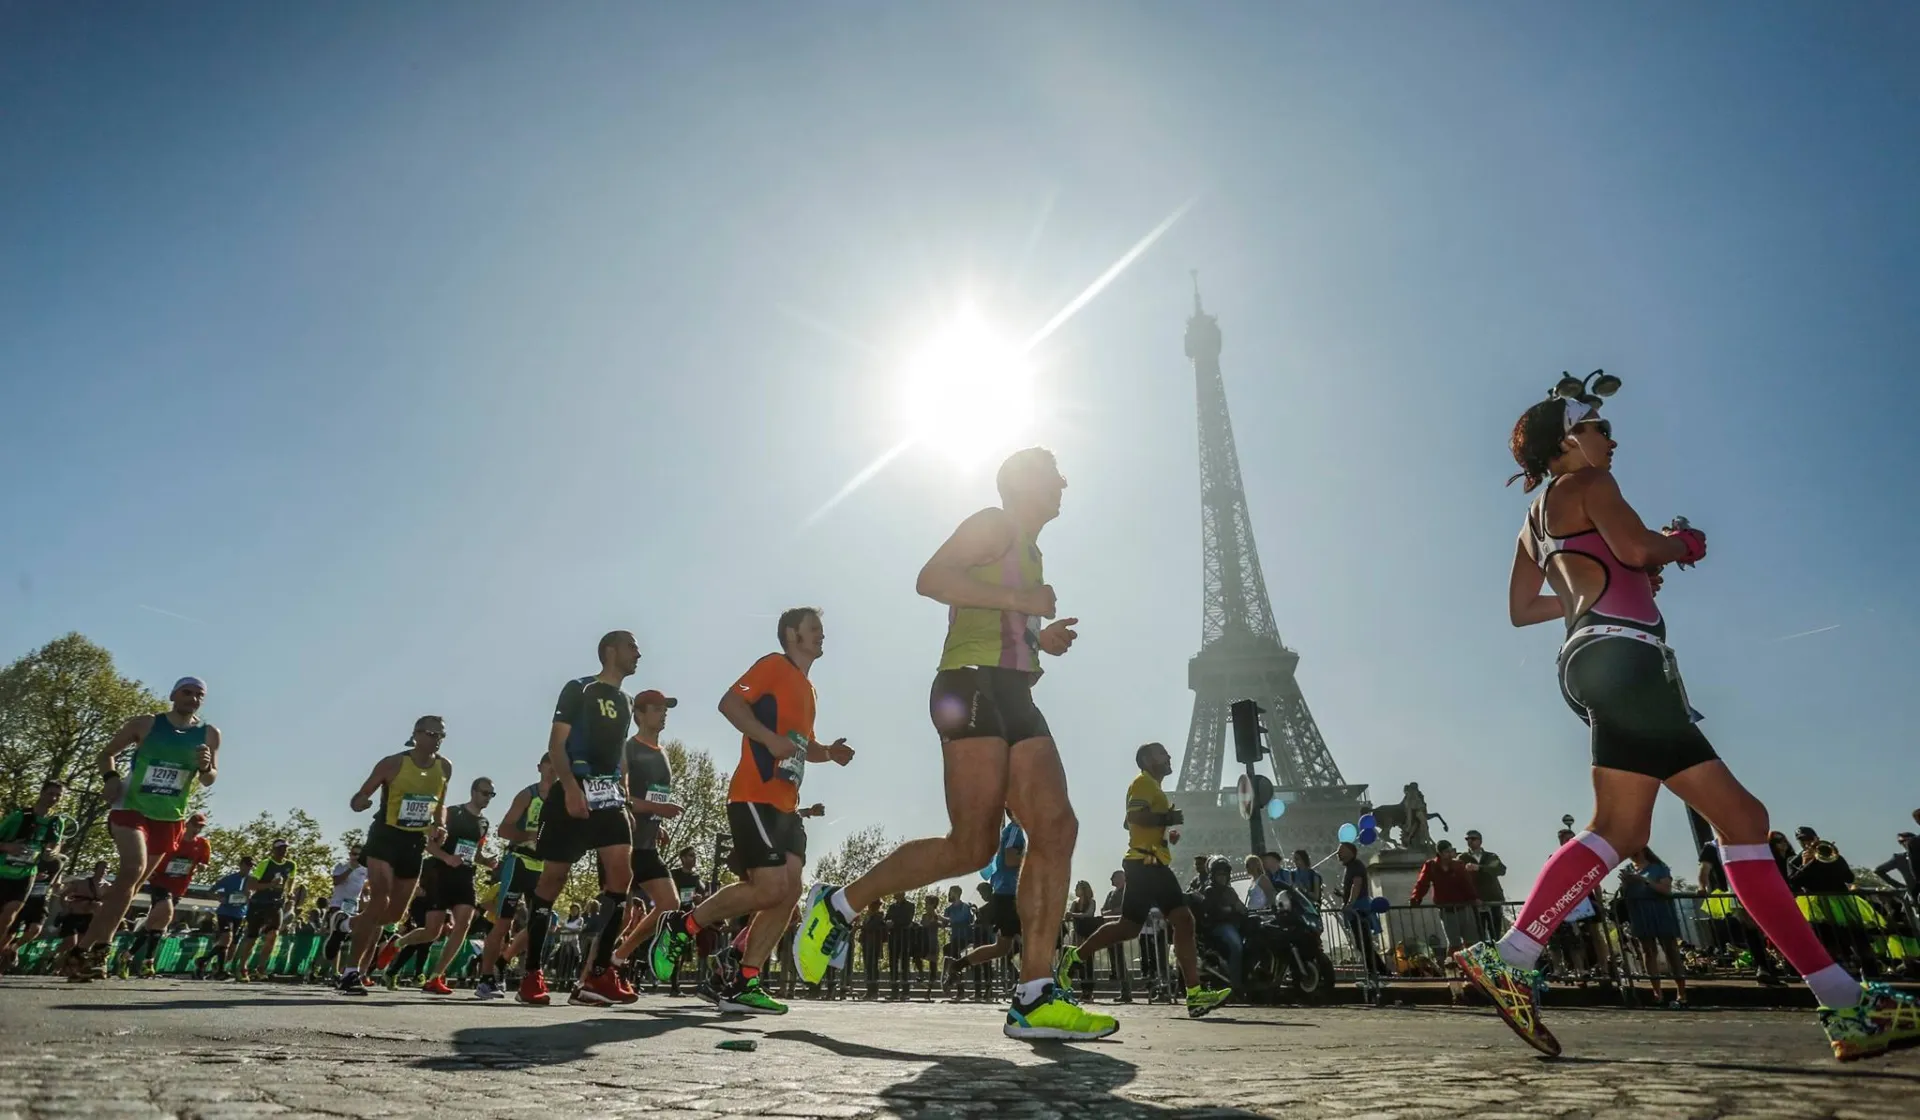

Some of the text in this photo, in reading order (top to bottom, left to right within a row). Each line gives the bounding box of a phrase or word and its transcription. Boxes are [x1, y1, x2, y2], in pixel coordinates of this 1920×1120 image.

[597, 698, 617, 718] 16
[152, 768, 178, 780] 12179
[588, 780, 619, 792] 2026
[406, 801, 429, 813] 10755
